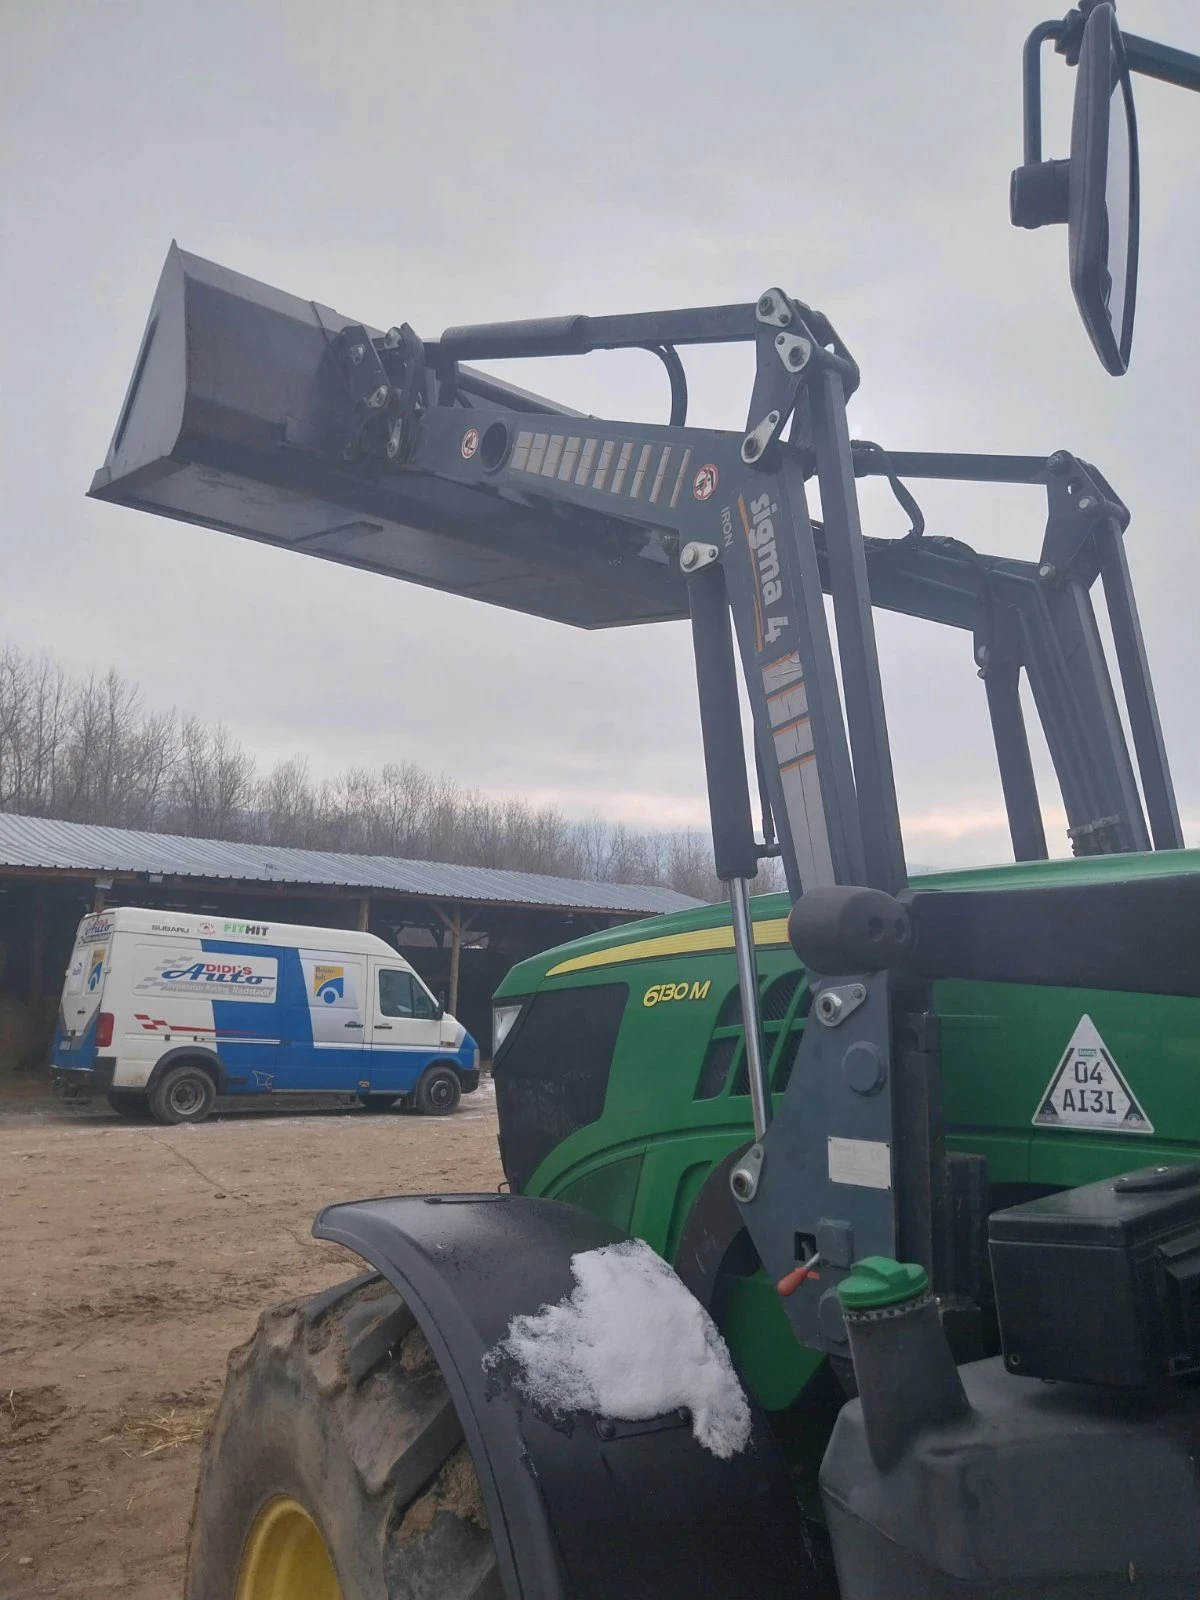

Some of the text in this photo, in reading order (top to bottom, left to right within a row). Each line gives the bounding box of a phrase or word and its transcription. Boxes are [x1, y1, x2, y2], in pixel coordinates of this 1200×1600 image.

[721, 506, 734, 547] IRON
[749, 493, 789, 643] sigma 4
[152, 925, 189, 934] SUBARU
[161, 963, 276, 985] Auto
[232, 986, 270, 997] Radstadt
[643, 980, 711, 1007] 6130 M
[1074, 1061, 1103, 1084] 04
